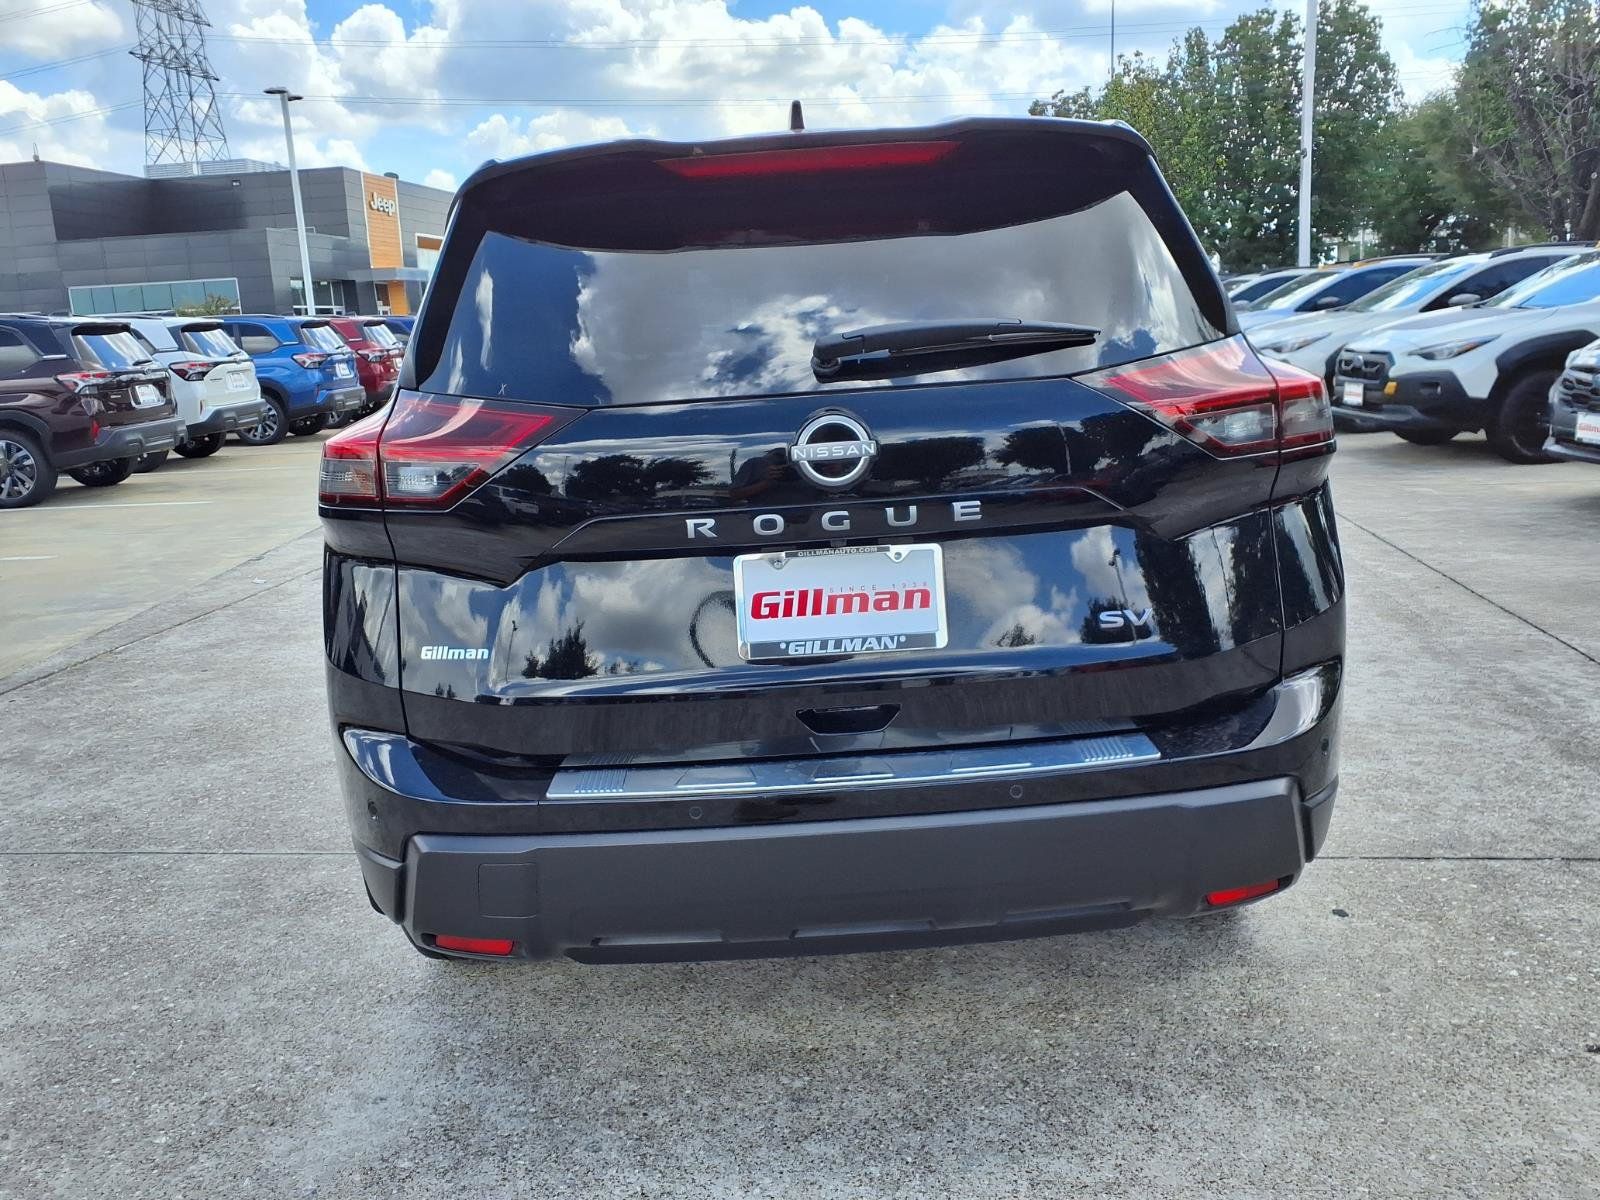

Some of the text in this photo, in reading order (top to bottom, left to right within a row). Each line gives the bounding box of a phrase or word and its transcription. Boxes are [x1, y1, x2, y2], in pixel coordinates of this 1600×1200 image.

[370, 192, 396, 216] Jeep
[793, 443, 876, 459] NISSAN
[686, 500, 983, 539] ROGUE
[797, 546, 878, 557] GILLMANAUTO.COM
[830, 584, 876, 593] SINCE
[751, 588, 931, 620] Gillman
[1099, 608, 1153, 628] SV
[420, 645, 489, 660] Gillman
[787, 635, 897, 655] GILLMAN
